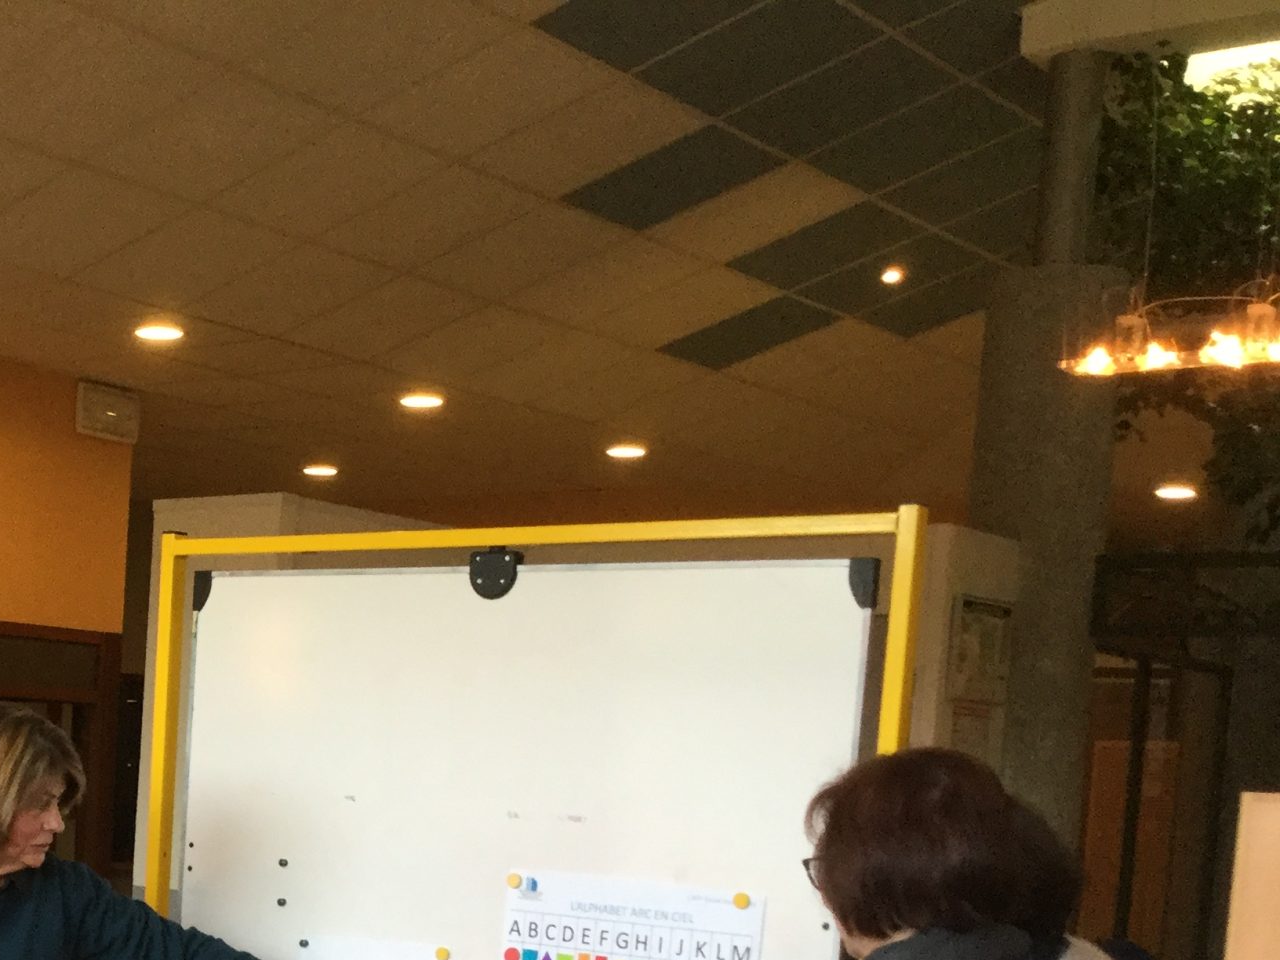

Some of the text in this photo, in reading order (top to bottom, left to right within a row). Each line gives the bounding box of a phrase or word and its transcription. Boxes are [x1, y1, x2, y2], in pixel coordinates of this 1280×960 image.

[508, 919, 522, 936] A
[528, 921, 539, 938] B
[545, 924, 557, 940] C
[562, 925, 575, 942] D
[581, 927, 591, 944] E
[599, 929, 609, 945] F
[615, 932, 629, 949] G
[635, 934, 648, 950] H
[658, 937, 663, 952] I
[676, 939, 684, 955] J
[695, 941, 707, 958] K
[716, 943, 725, 960] L
